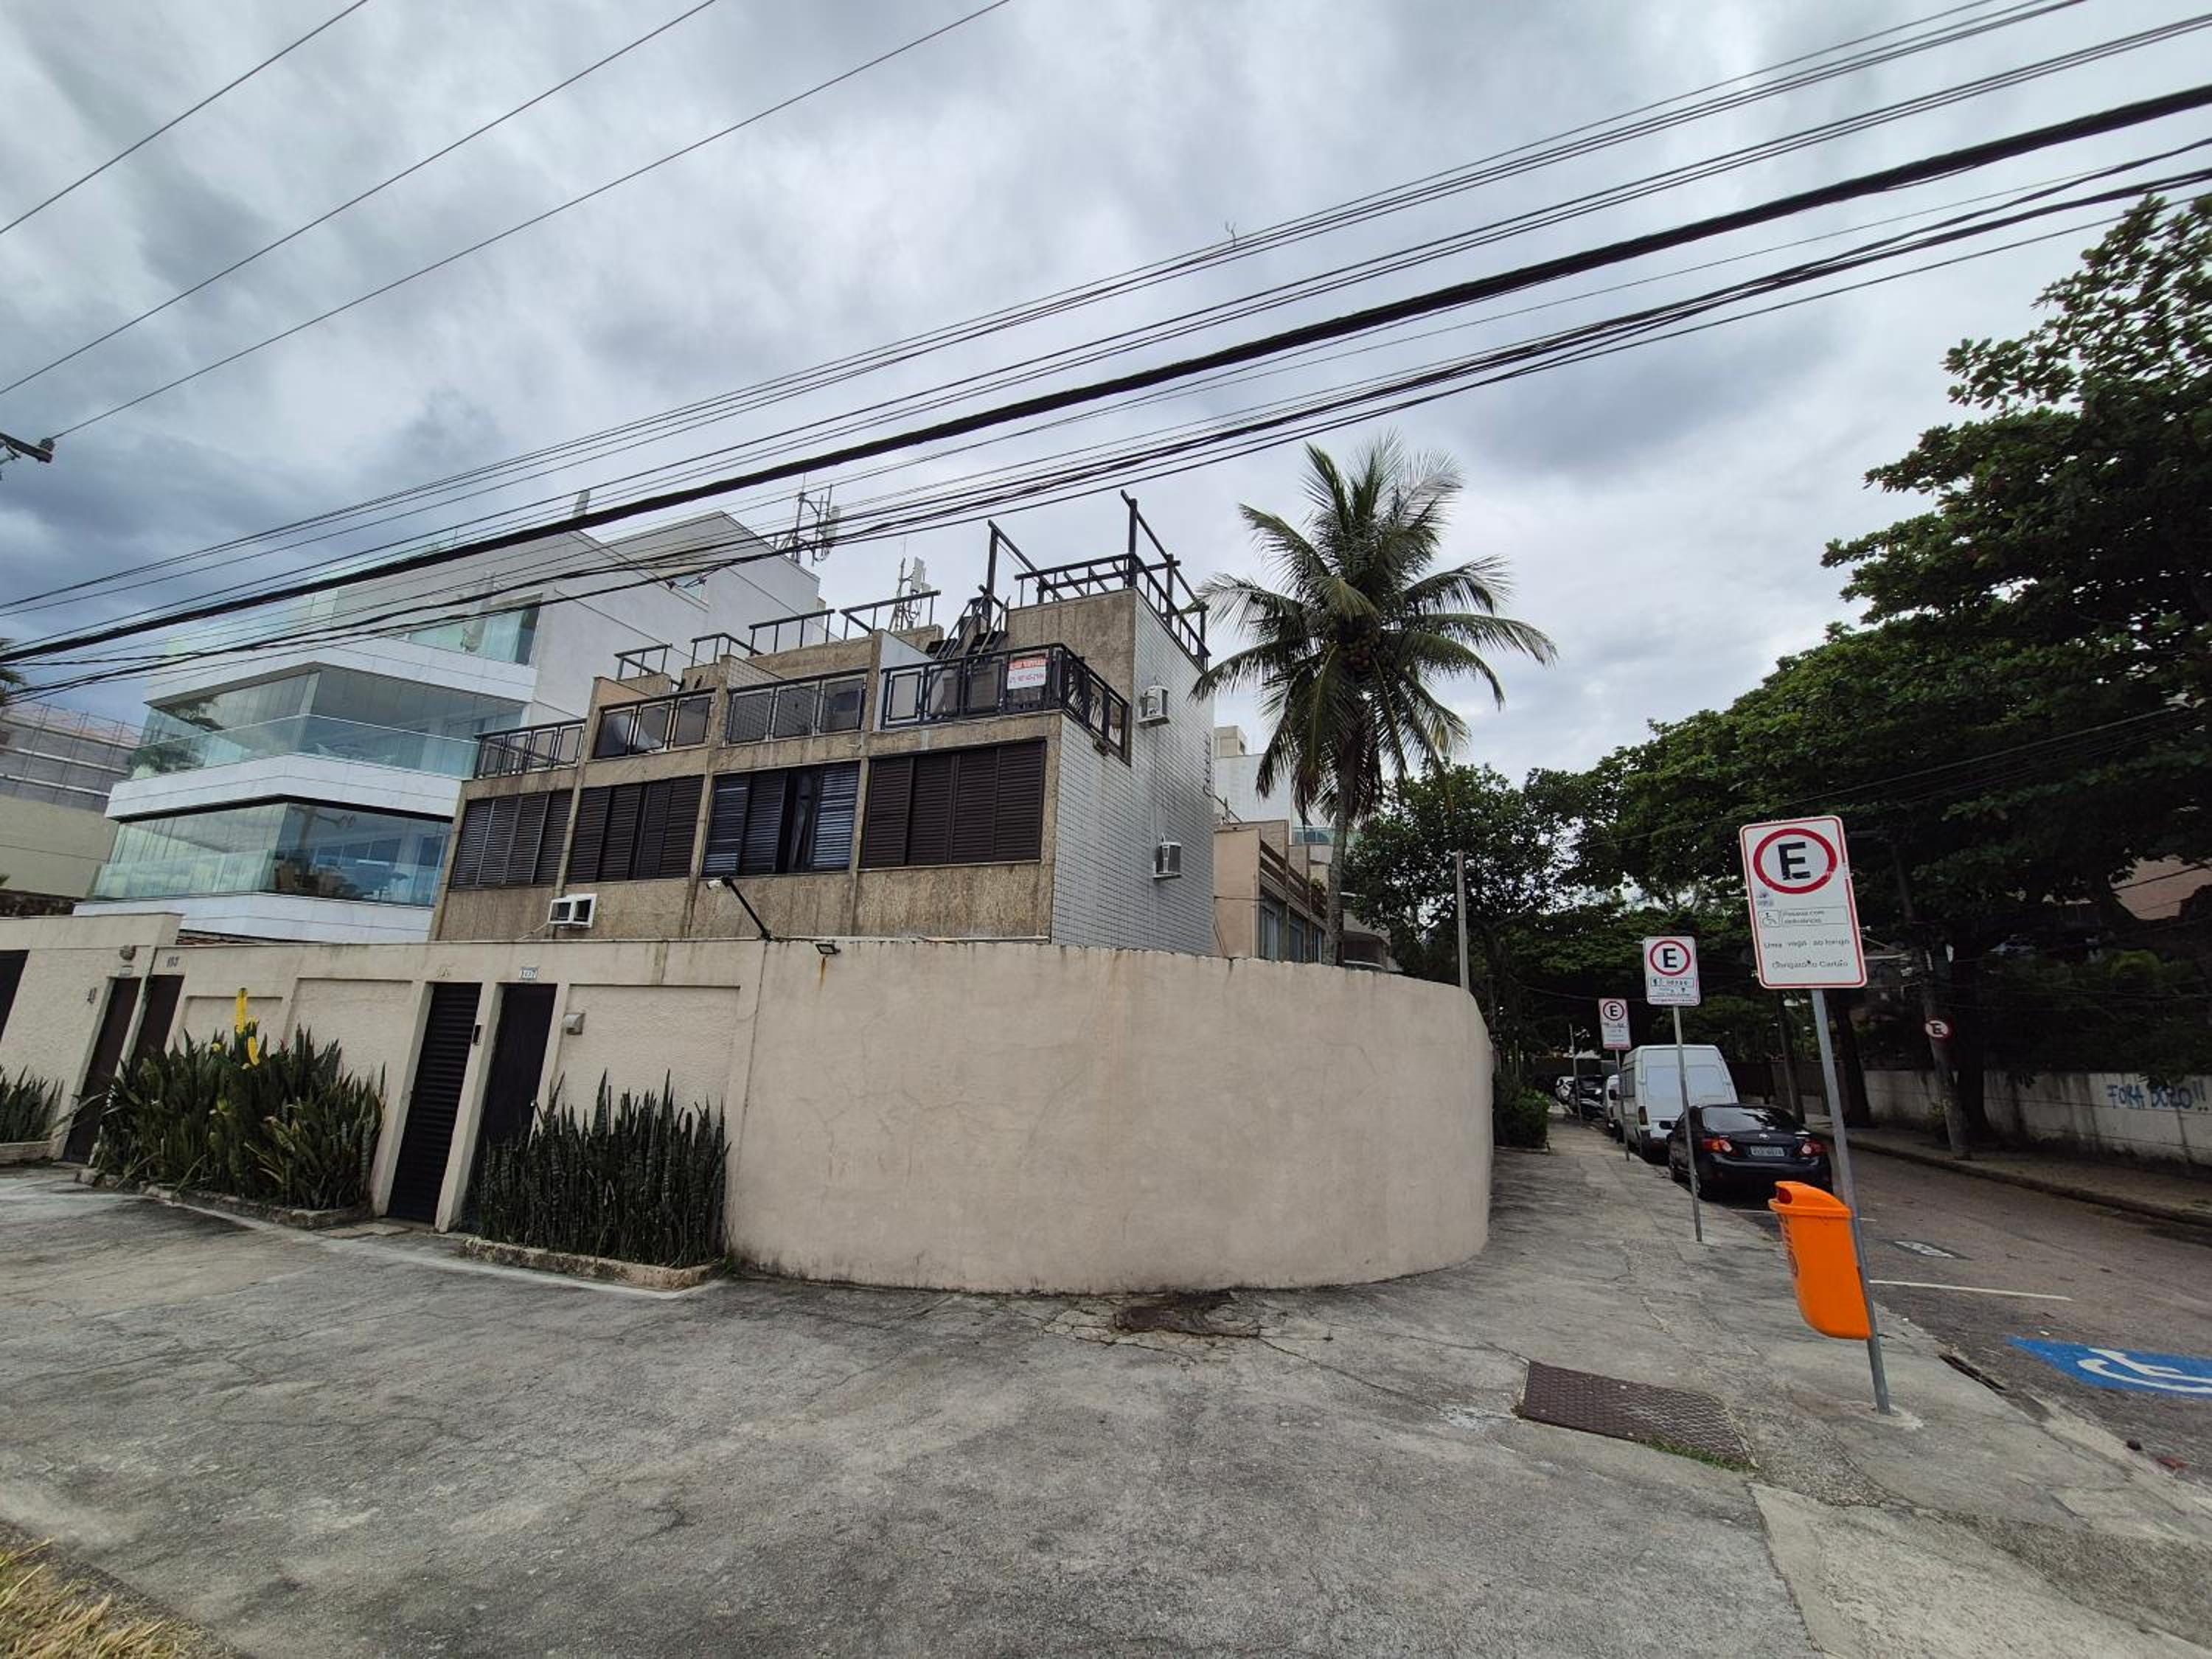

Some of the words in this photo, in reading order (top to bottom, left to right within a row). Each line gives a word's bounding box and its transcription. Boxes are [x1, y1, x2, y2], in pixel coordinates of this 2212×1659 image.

[1778, 841, 1811, 880] E
[1662, 947, 1678, 968] E
[1610, 1005, 1618, 1017] E
[2106, 1084, 2146, 1110] FORA
